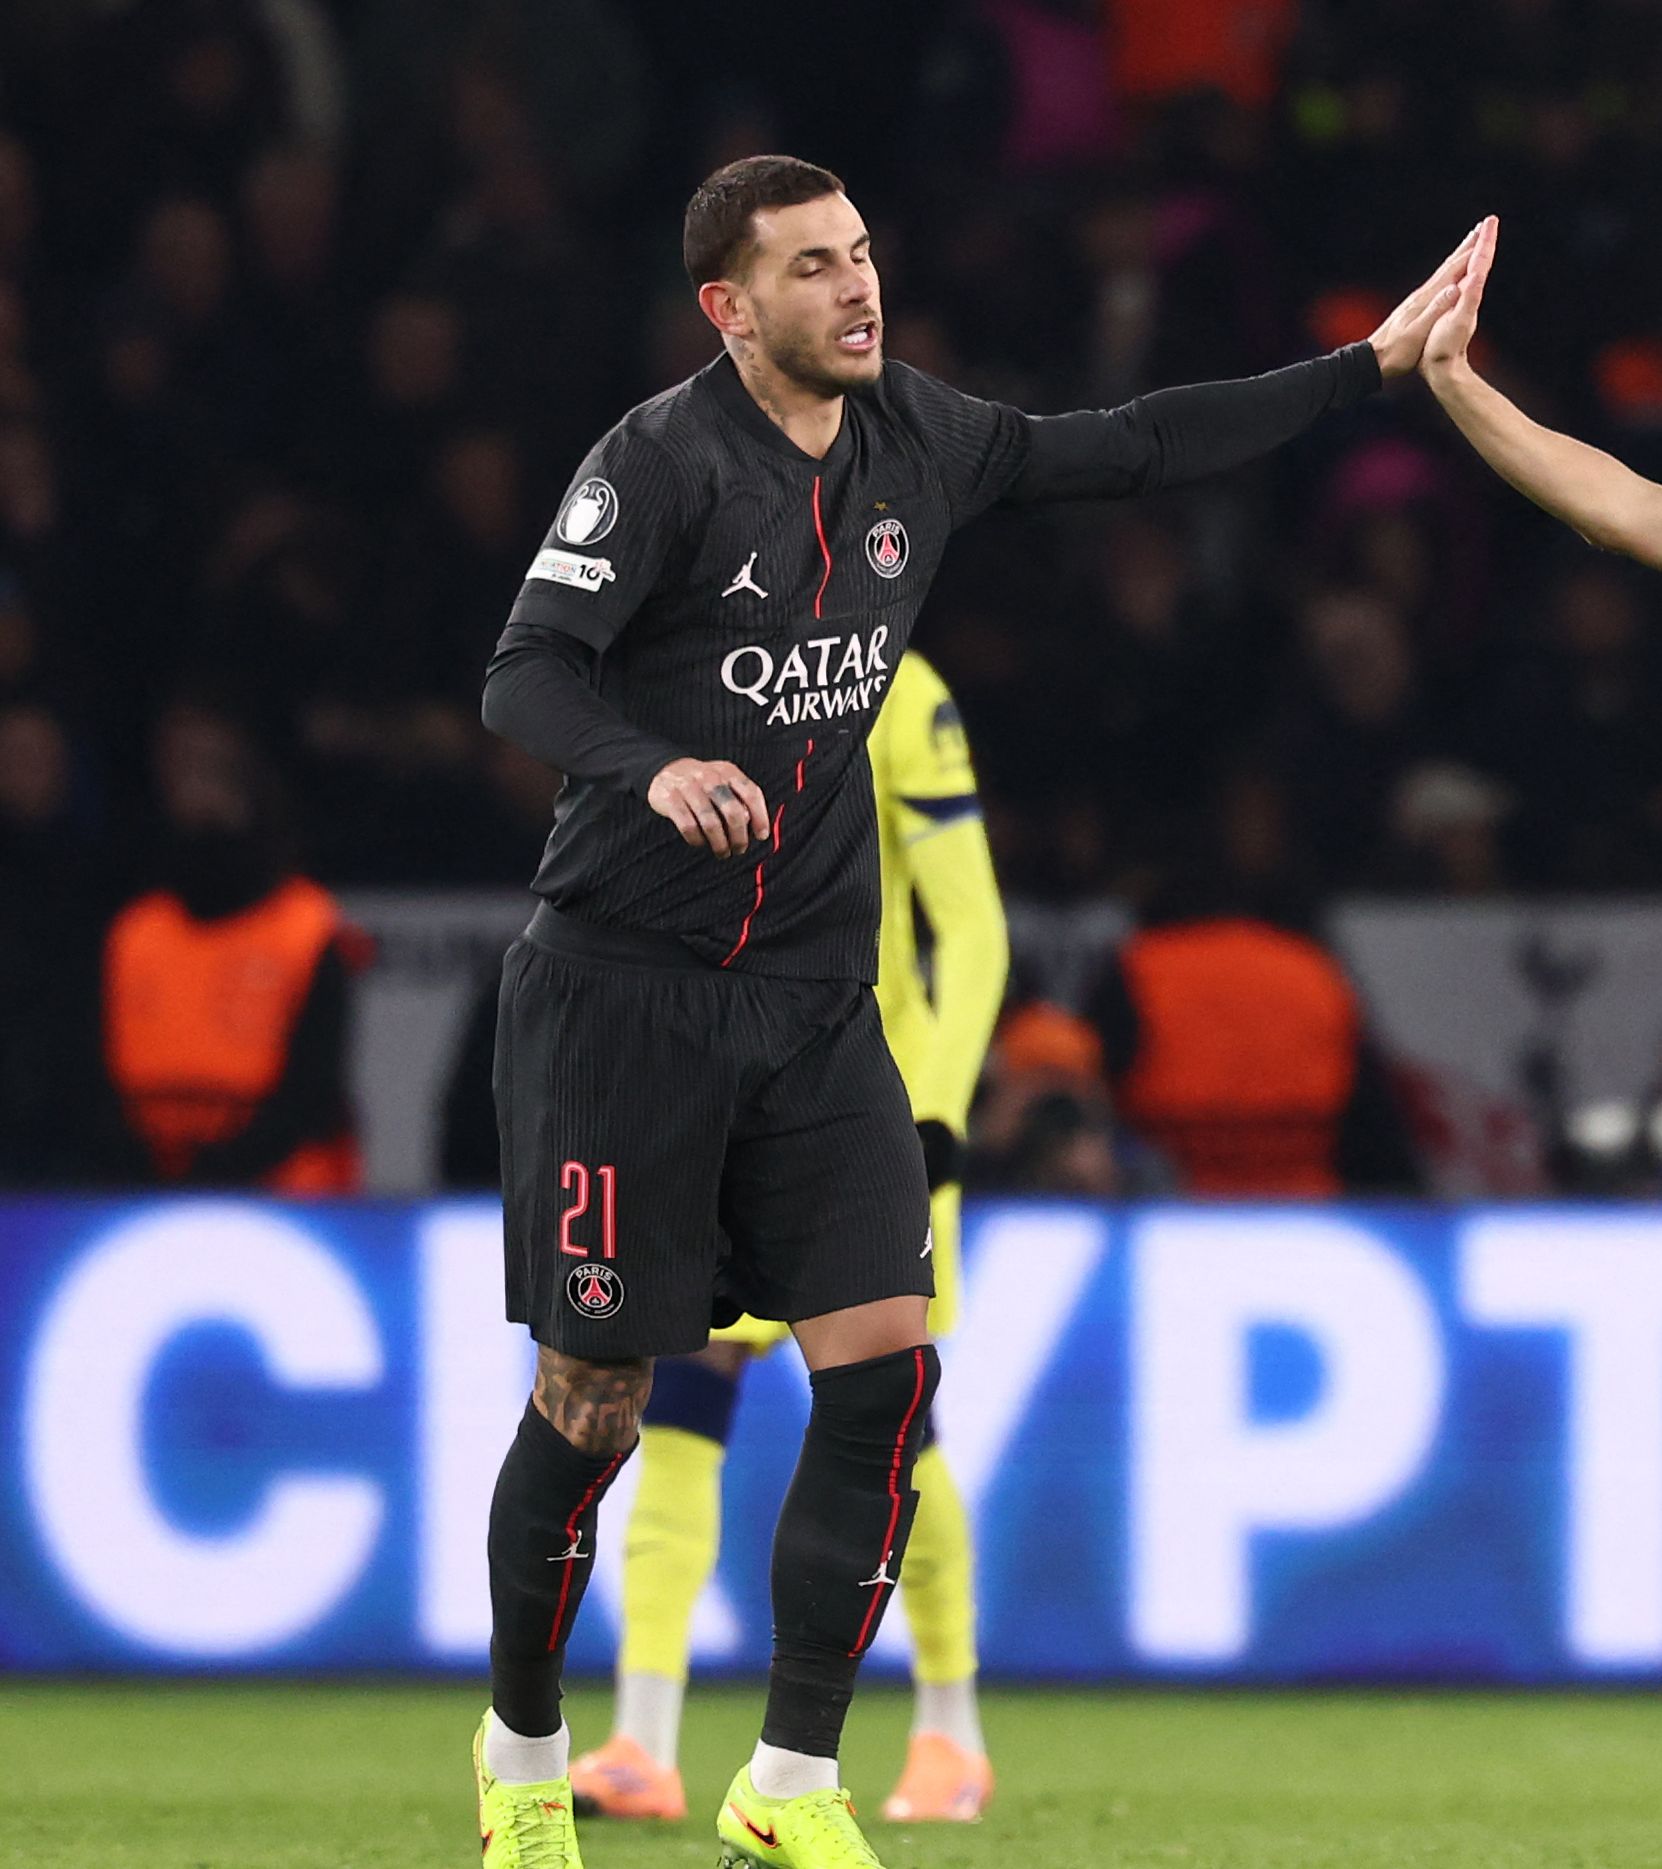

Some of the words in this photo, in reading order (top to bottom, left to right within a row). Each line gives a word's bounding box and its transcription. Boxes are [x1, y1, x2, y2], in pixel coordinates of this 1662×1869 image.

[872, 522, 901, 538] PARIS
[720, 624, 889, 706] QATAR
[559, 1159, 616, 1259] 21
[575, 1266, 613, 1281] PARIS
